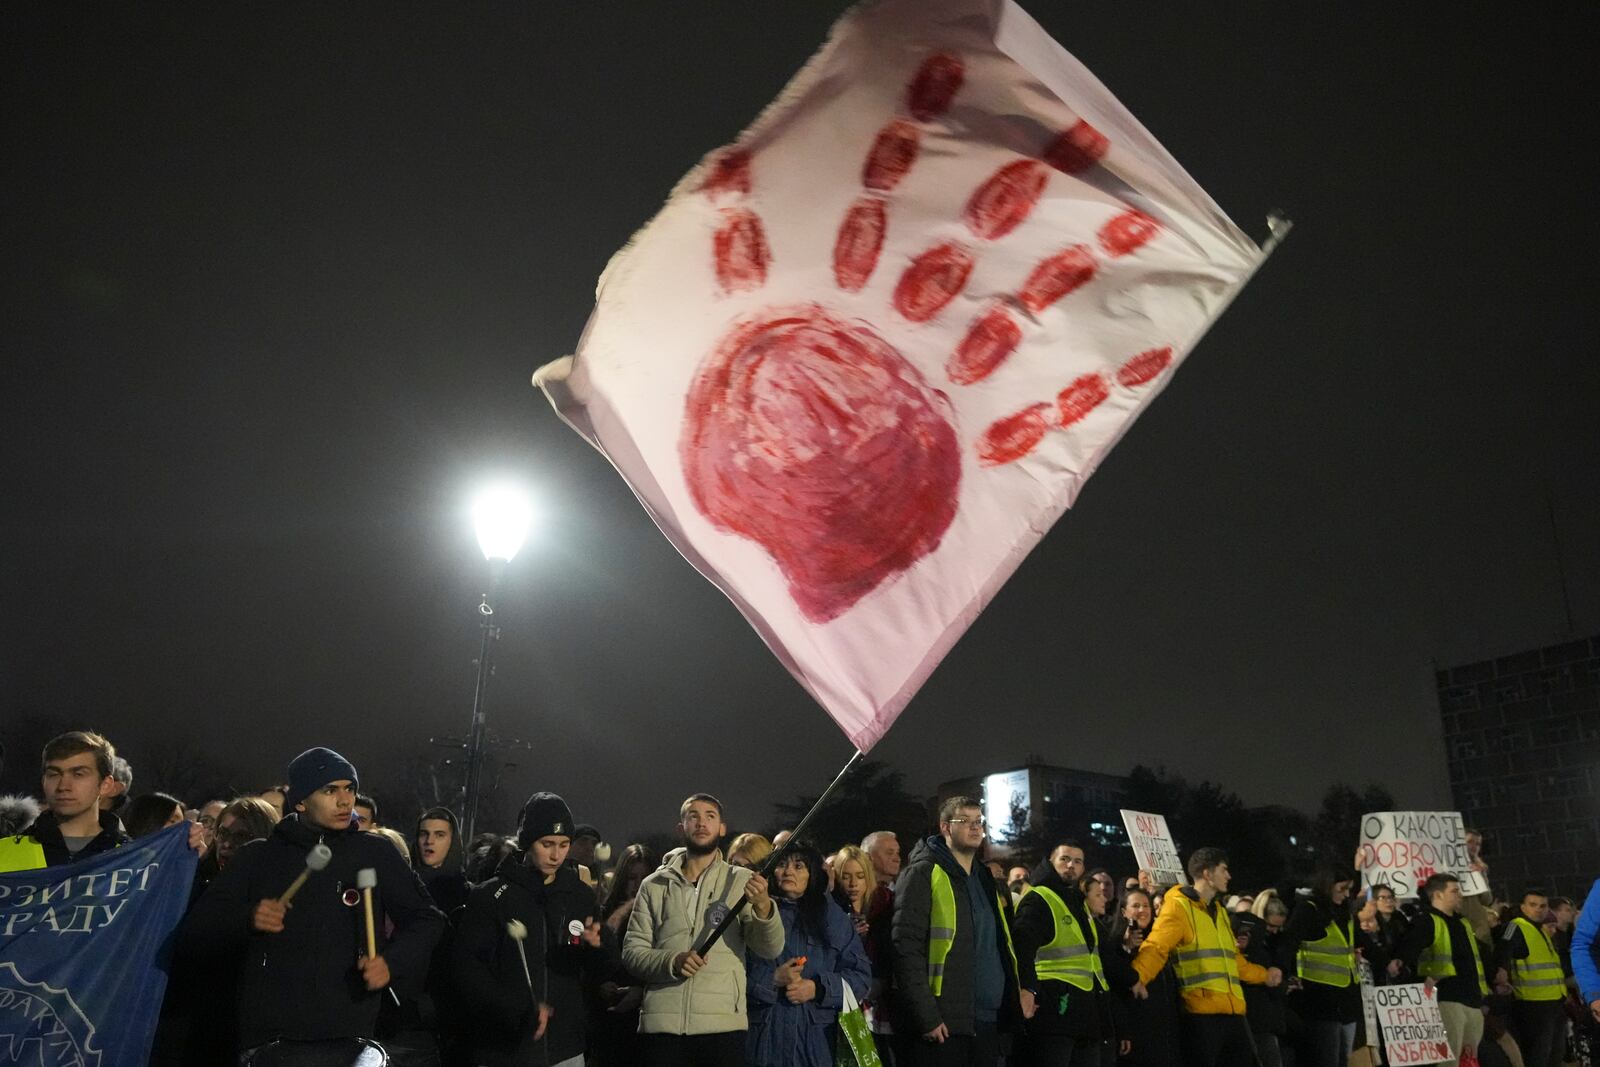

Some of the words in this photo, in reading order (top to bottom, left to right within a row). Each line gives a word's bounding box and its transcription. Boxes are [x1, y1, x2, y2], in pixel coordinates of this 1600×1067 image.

[1364, 816, 1382, 840] O
[1393, 815, 1441, 839] KAKO
[1362, 842, 1435, 869] DOBRO
[0, 899, 128, 937] РАДУ
[1376, 986, 1422, 1007] ОВАЈ
[1387, 1007, 1428, 1025] ГРАД
